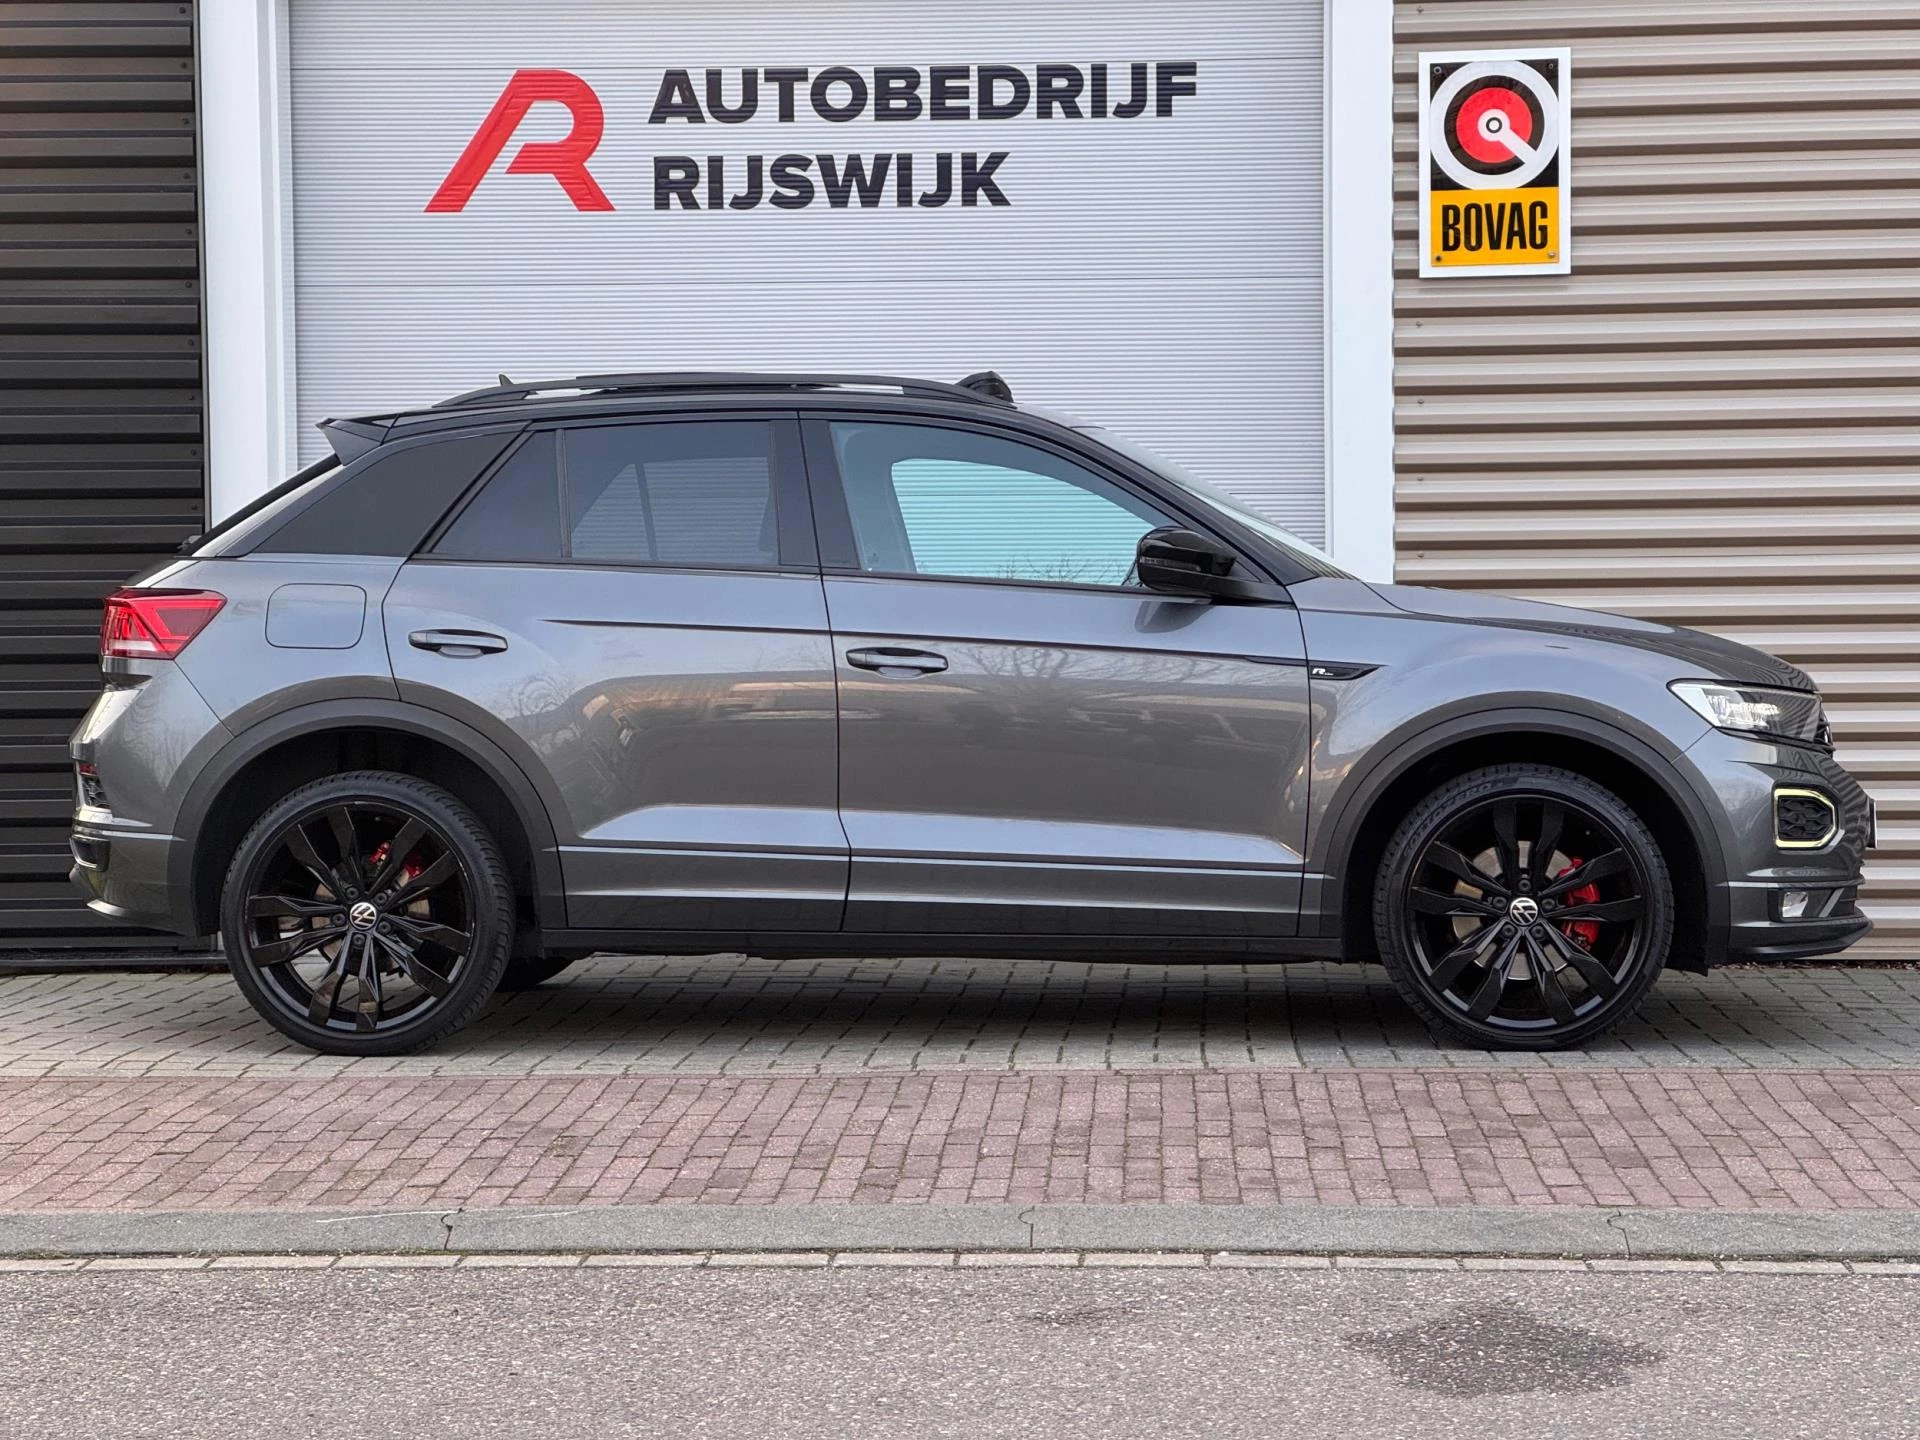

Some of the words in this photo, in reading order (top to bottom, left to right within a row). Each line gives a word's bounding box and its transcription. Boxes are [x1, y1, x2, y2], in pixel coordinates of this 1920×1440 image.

[648, 63, 1197, 124] AUTOBEDRIJF
[654, 151, 1011, 210] RIJSWIJK
[1442, 201, 1548, 252] BOVAG
